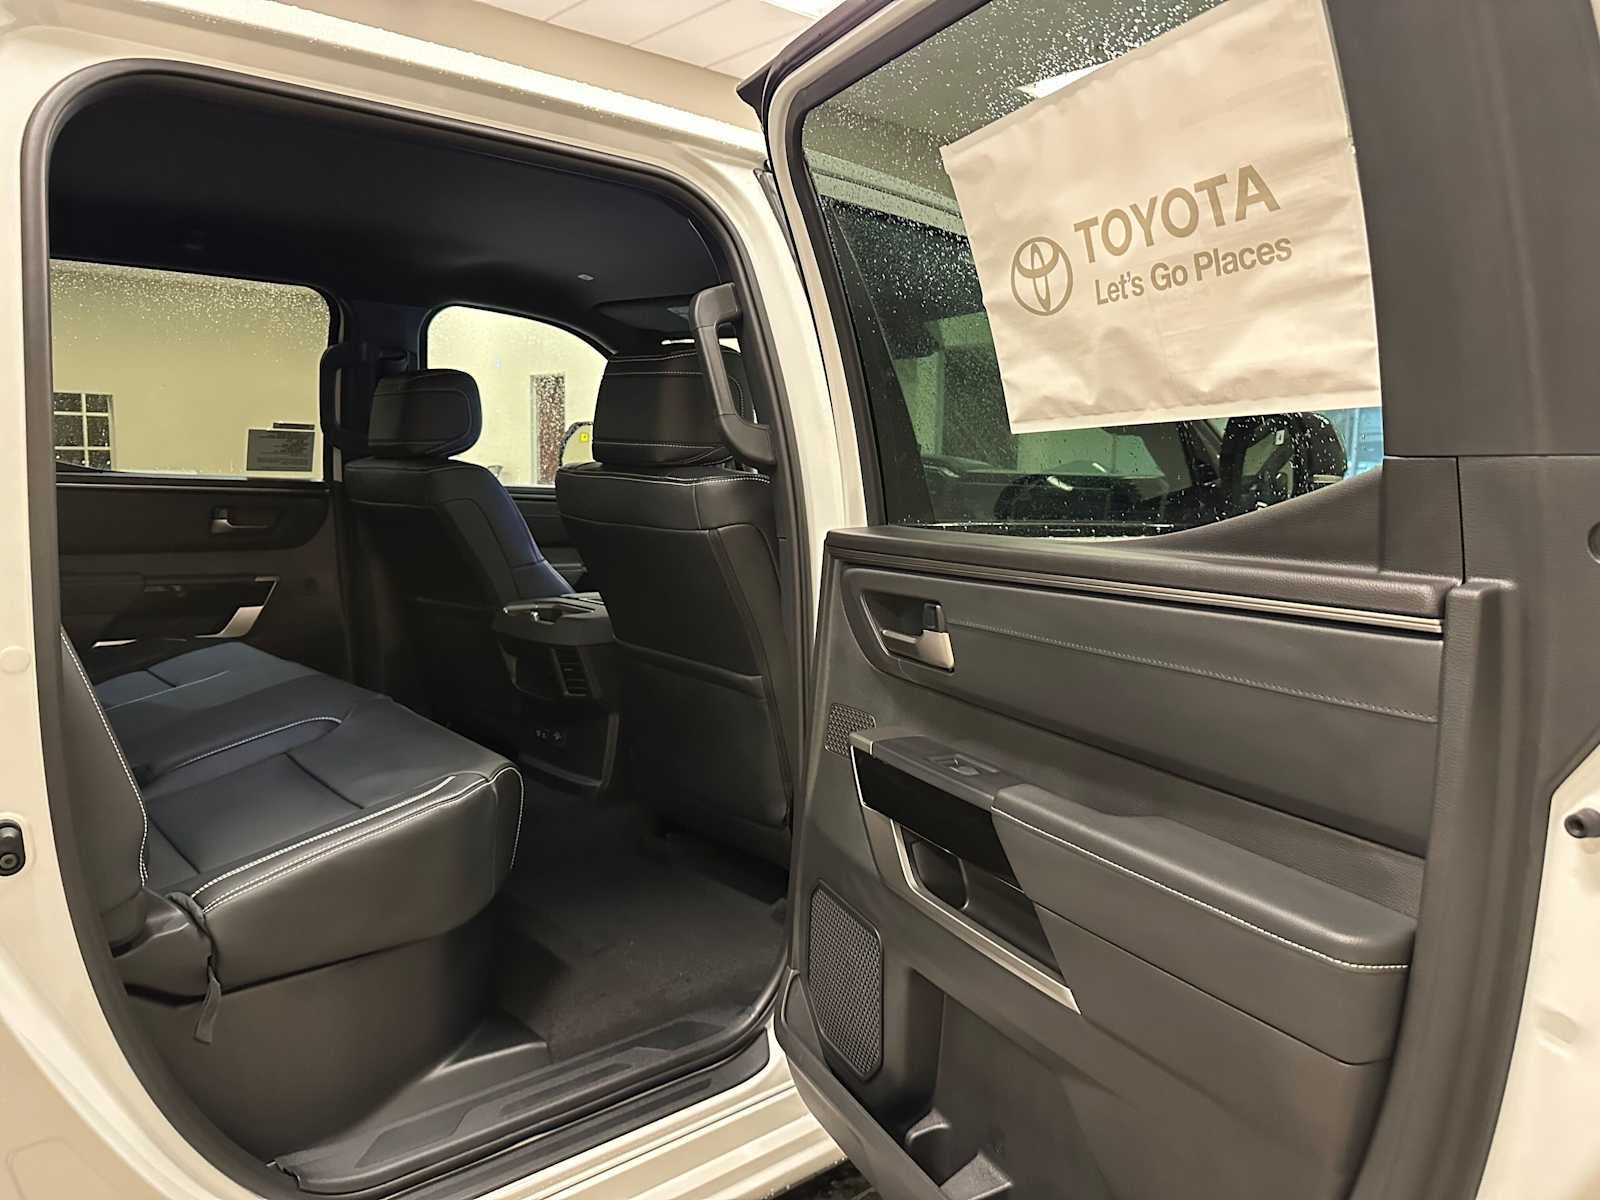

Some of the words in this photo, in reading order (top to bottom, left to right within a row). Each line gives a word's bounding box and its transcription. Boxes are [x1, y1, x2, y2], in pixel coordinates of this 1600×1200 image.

[1073, 164, 1281, 264] TOYOTA
[1094, 272, 1145, 306] Let's
[1150, 262, 1189, 291] Go
[1193, 237, 1293, 282] Places
